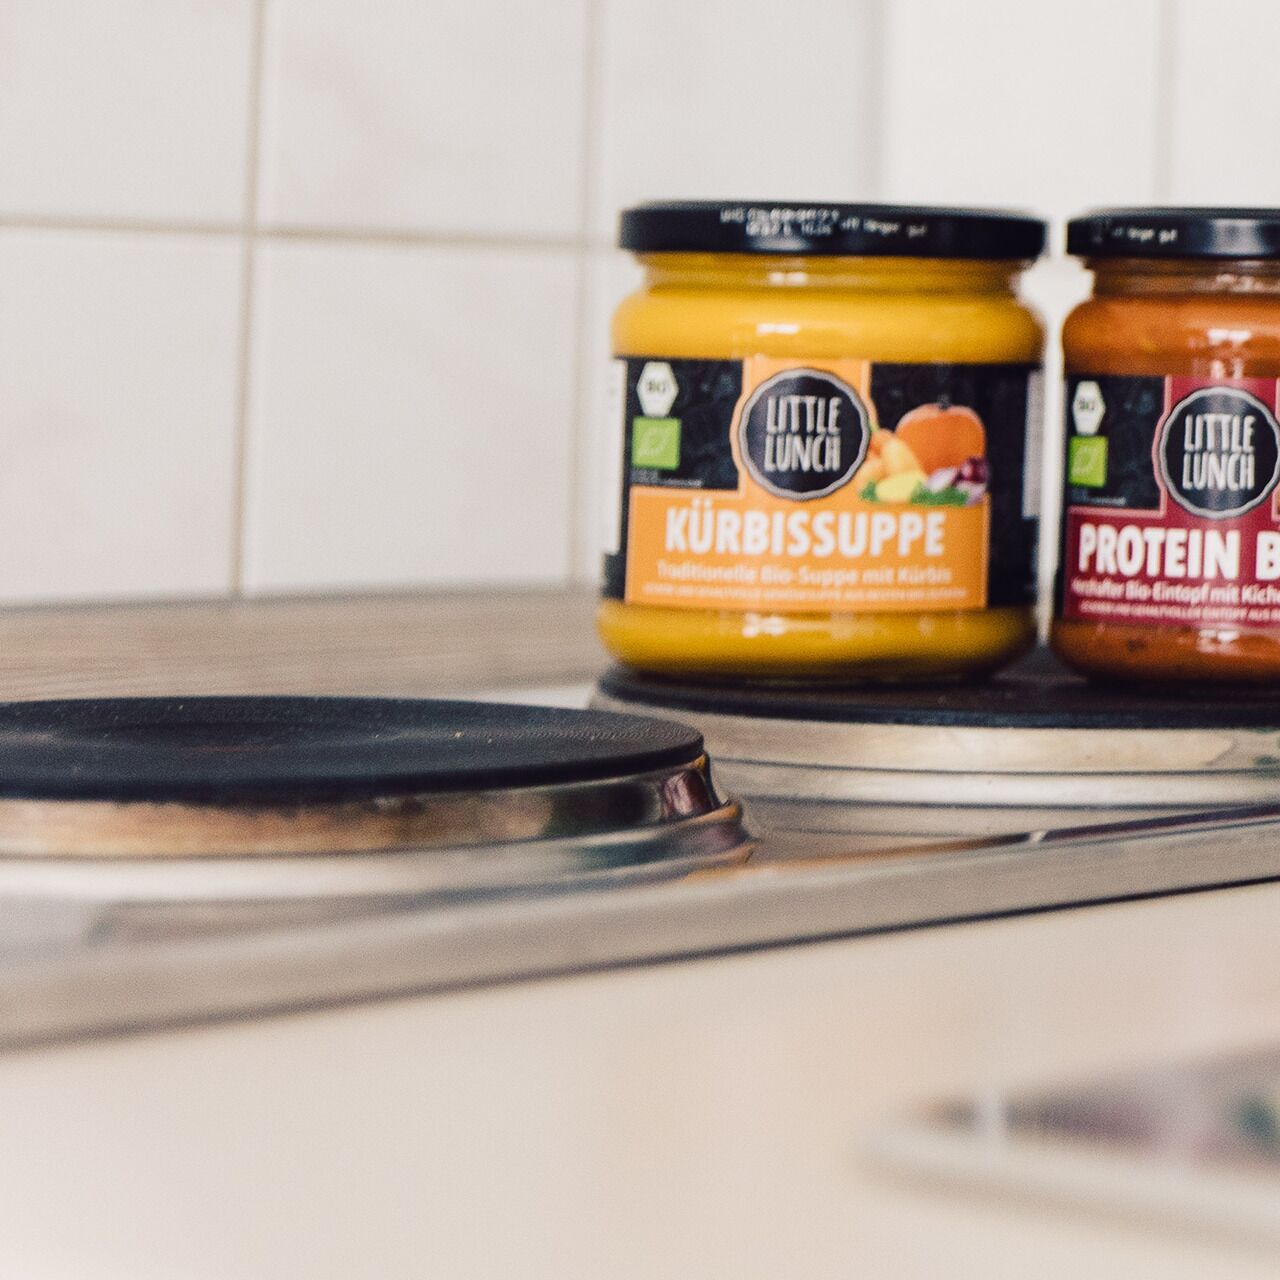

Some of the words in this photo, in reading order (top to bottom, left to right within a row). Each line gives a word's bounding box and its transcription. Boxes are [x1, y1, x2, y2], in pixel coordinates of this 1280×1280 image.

[766, 394, 842, 434] LITTLE
[1183, 412, 1256, 452] LITTLE
[764, 432, 842, 473] LUNCH
[1182, 451, 1256, 491] LUNCH
[664, 499, 947, 557] KÜRBISSUPPE
[1078, 523, 1241, 580] PROTEIN
